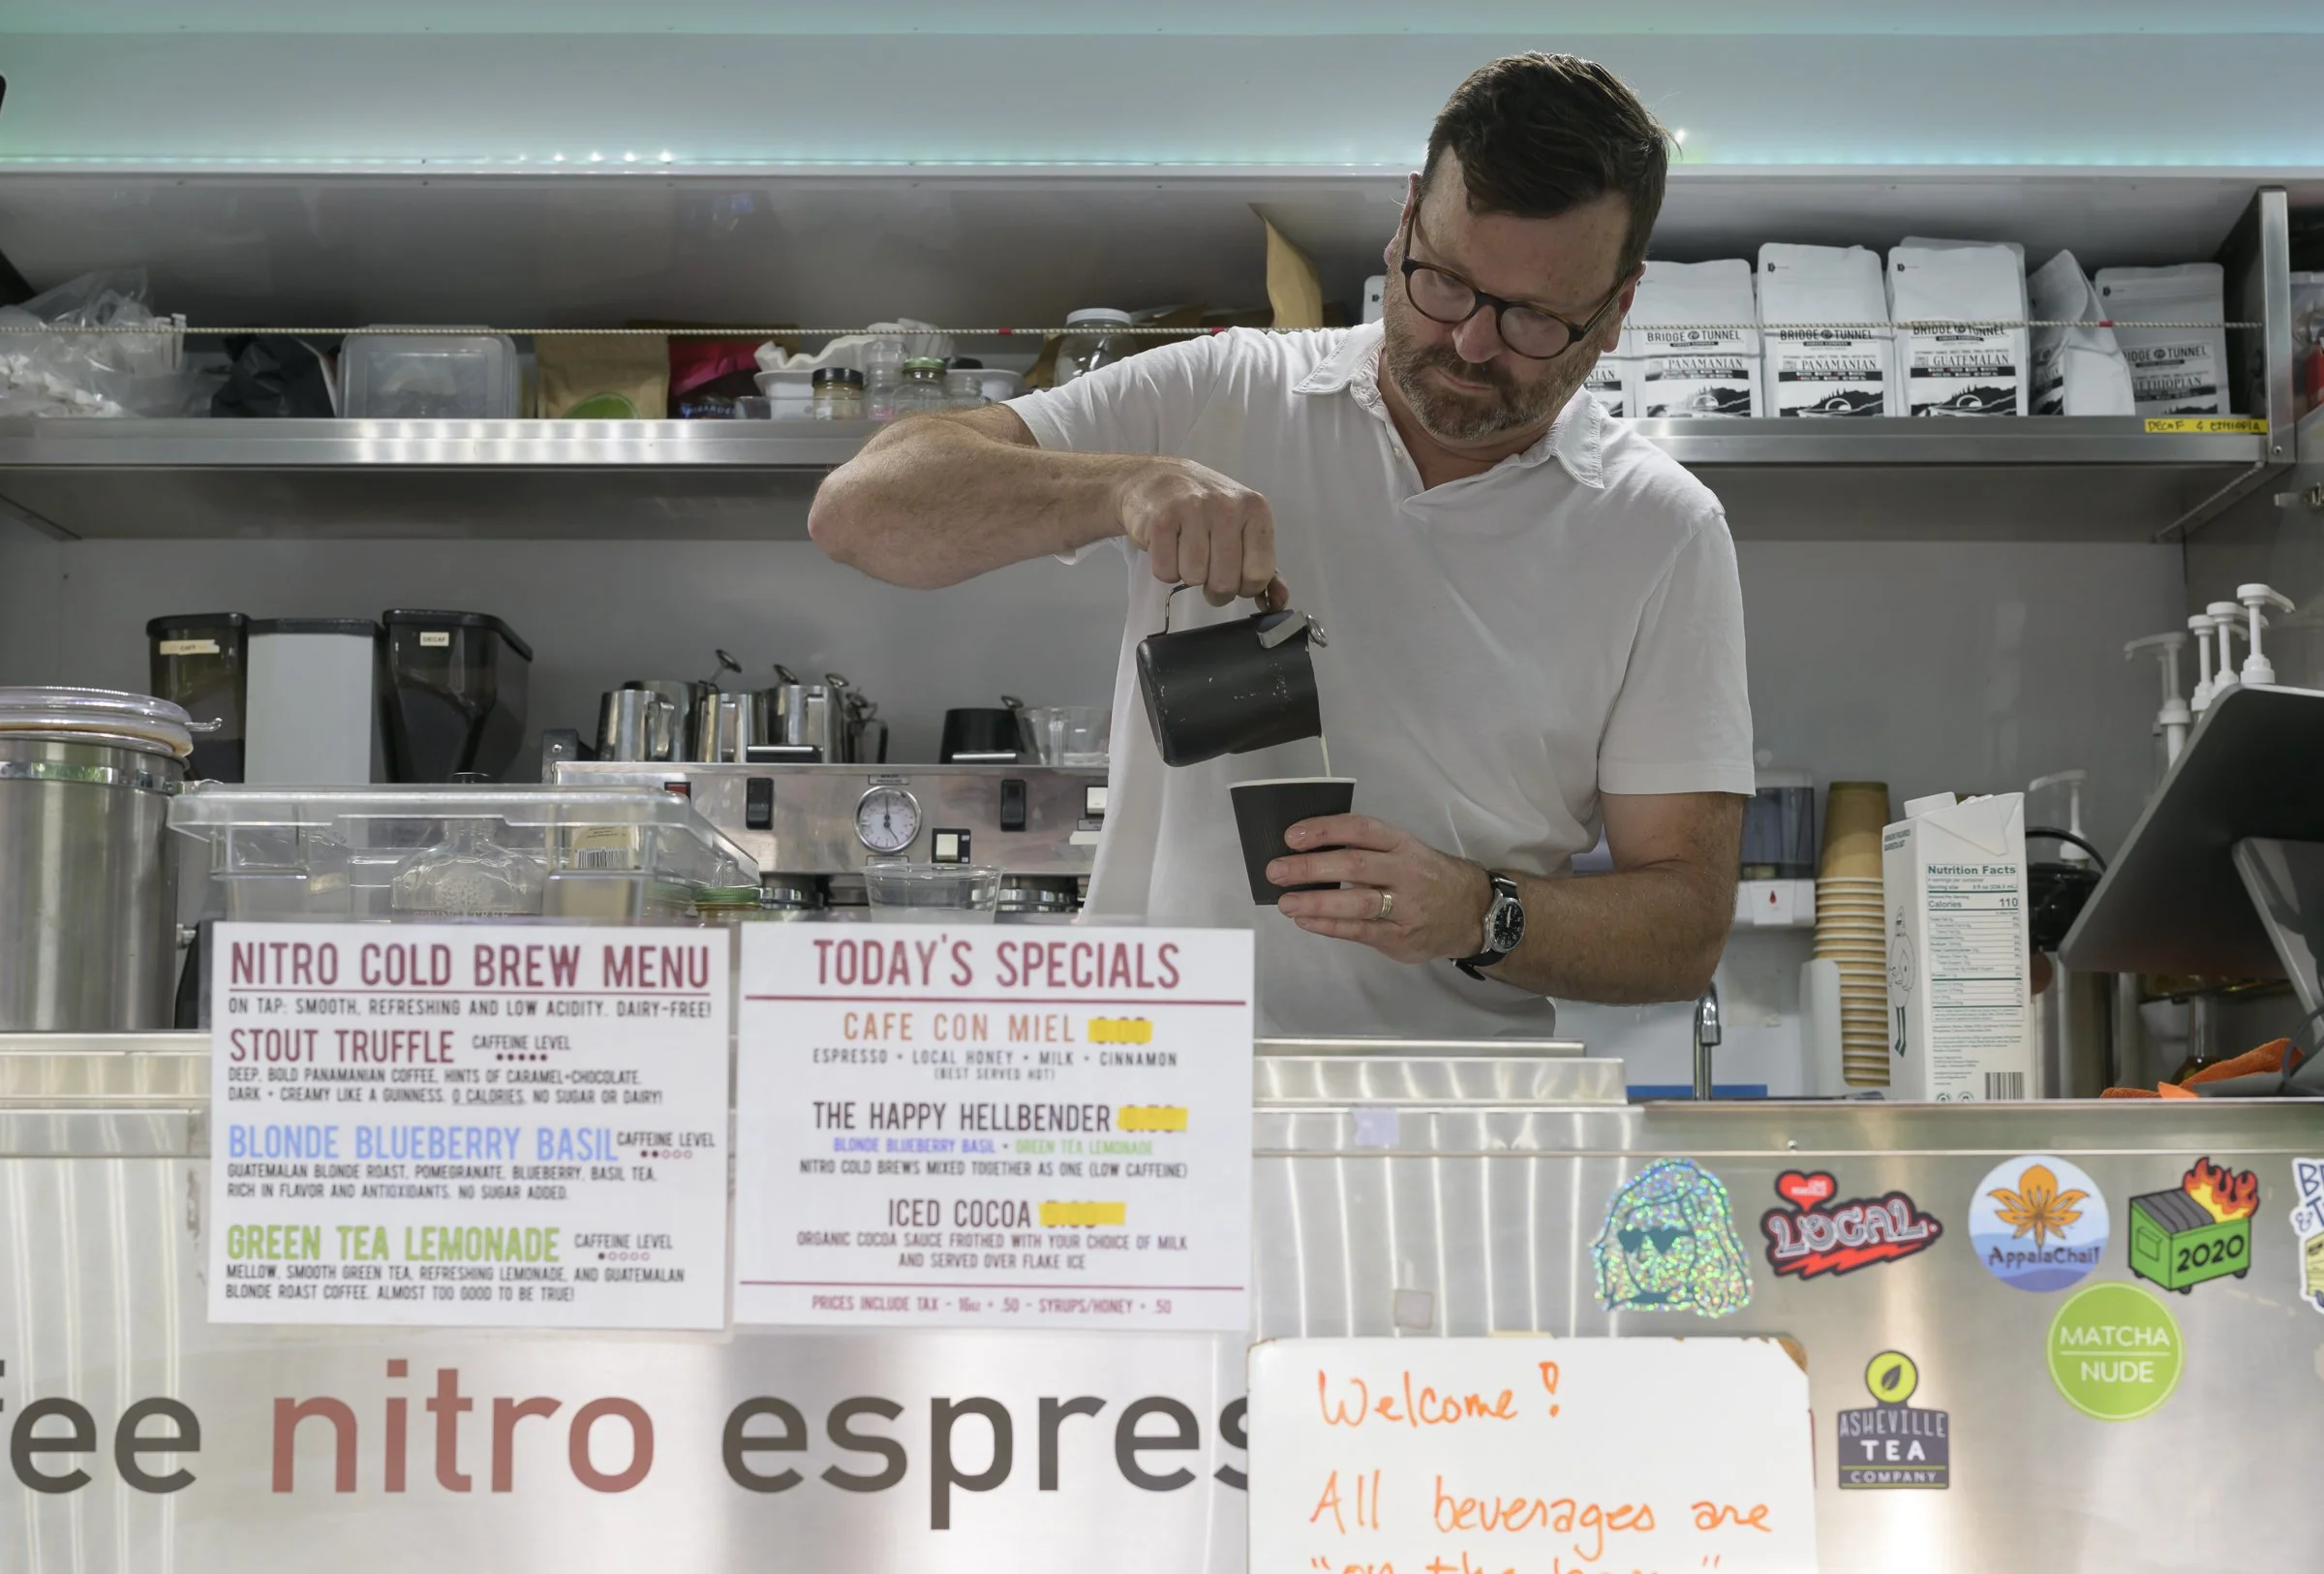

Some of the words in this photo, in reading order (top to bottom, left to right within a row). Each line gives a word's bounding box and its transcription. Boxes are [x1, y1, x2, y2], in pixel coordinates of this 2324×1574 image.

[1647, 331, 1686, 342] BRIDGE
[1701, 329, 1741, 341] TUNNEL
[1780, 329, 1819, 341] BRIDGE
[1834, 329, 1874, 340] TUNNEL
[1667, 357, 1743, 370] PANAMANIAN
[1801, 359, 1877, 370] PANAMANIAN
[1933, 354, 2009, 367] GUATEMALAN
[1928, 865, 1978, 875] Nutrition
[1982, 865, 2017, 875] Facts
[1999, 897, 2019, 908] 110
[231, 941, 338, 986] NITRO
[361, 942, 451, 987] COLD
[474, 943, 580, 988] BREW
[603, 944, 708, 989] MENU
[812, 934, 973, 986] TODAY'S
[996, 941, 1179, 989] SPECIALS
[229, 997, 247, 1014] ON
[258, 997, 287, 1014] TAP:
[369, 998, 460, 1016] REFRESHING
[470, 999, 498, 1016] AND
[507, 1000, 537, 1016] LOW
[617, 1000, 711, 1018] DAIRY-FREE!
[843, 1011, 912, 1041] CAFE
[933, 1012, 988, 1041] CON
[1009, 1014, 1074, 1042] MIEL
[230, 1028, 319, 1063] STOUT
[334, 1029, 454, 1064] TRUFFLE
[473, 1034, 527, 1049] CAFFEINE
[535, 1034, 571, 1050] LEVEL
[813, 1048, 887, 1064] ESPRESSO
[913, 1049, 955, 1066] LOCAL
[966, 1049, 1013, 1066] HONEY
[1039, 1051, 1073, 1066] MILK
[1100, 1051, 1177, 1066] CINNAMON
[813, 1101, 856, 1129] THE
[870, 1101, 946, 1130] HAPPY
[961, 1102, 1110, 1132] HELLBENDER
[229, 1124, 340, 1159] BLONDE
[355, 1125, 521, 1160] BLUEBERRY
[536, 1126, 618, 1161] BASIL
[617, 1131, 672, 1147] CAFFEINE
[680, 1131, 715, 1148] LEVEL
[834, 1137, 879, 1153] BLONDE
[886, 1137, 955, 1154] BLUEBERRY
[962, 1138, 994, 1154] BASIL
[228, 1163, 308, 1178] GUATEMALAN
[314, 1163, 359, 1179] BLONDE
[591, 1166, 625, 1181] BASIL
[799, 1158, 836, 1173] NITRO
[841, 1158, 872, 1175] COLD
[877, 1159, 921, 1174] BREWS
[926, 1160, 965, 1175] MIXED
[972, 1160, 1031, 1176] TOGETHER
[1037, 1161, 1054, 1176] AS
[1059, 1161, 1083, 1177] ONE
[1089, 1162, 1120, 1176] (LOW
[1126, 1162, 1187, 1178] CAFFEINE)
[228, 1183, 256, 1197] RICH
[261, 1183, 274, 1196] IN
[280, 1183, 324, 1198] FLAVOR
[330, 1184, 355, 1198] AND
[458, 1185, 475, 1199] NO
[481, 1185, 521, 1199] SUGAR
[889, 1198, 939, 1227] ICED
[955, 1199, 1030, 1228] COCOA
[1767, 1199, 1929, 1258] LOCAL
[227, 1224, 321, 1260] GREEN
[336, 1225, 389, 1261] TEA
[405, 1225, 560, 1262] LEMONADE
[574, 1233, 629, 1249] CAFFEINE
[637, 1234, 674, 1249] LEVEL
[797, 1231, 850, 1247] ORGANIC
[857, 1231, 897, 1247] COCOA
[904, 1232, 942, 1248] SAUCE
[949, 1232, 1004, 1249] FROTHED
[1011, 1234, 1042, 1248] WITH
[1049, 1234, 1080, 1249] YOUR
[1086, 1233, 1128, 1250] CHOICE
[1137, 1234, 1150, 1250] OF
[1158, 1236, 1187, 1250] MILK
[899, 1252, 925, 1267] AND
[931, 1252, 978, 1268] SERVED
[984, 1253, 1017, 1269] OVER
[1023, 1254, 1059, 1269] FLAKE
[1066, 1253, 1085, 1270] ICE
[2176, 1234, 2245, 1273] 2020
[287, 1264, 336, 1280] SMOOTH
[342, 1265, 382, 1281] GREEN
[419, 1265, 494, 1281] REFRESHING
[574, 1267, 598, 1281] AND
[604, 1267, 685, 1282] GUATEMALAN
[226, 1283, 271, 1299] BLONDE
[278, 1283, 317, 1299] ROAST
[377, 1285, 425, 1300] ALMOST
[433, 1285, 454, 1301] TOO
[460, 1285, 492, 1301] GOOD
[499, 1285, 512, 1301] TO
[518, 1285, 534, 1302] BE
[540, 1286, 574, 1302] TRUE!
[2060, 1326, 2171, 1346] MATCHA
[2081, 1361, 2155, 1383] NUDE
[1318, 1369, 1518, 1428] Welcome
[0, 1360, 200, 1494] ee
[270, 1358, 655, 1494] nitro
[1839, 1408, 1946, 1438] ASHEVILLE
[1859, 1439, 1926, 1462] TEA
[1850, 1470, 1937, 1483] COMPANY
[1309, 1468, 1381, 1534] All
[1433, 1474, 1657, 1561] beverages
[1690, 1498, 1773, 1532] are
